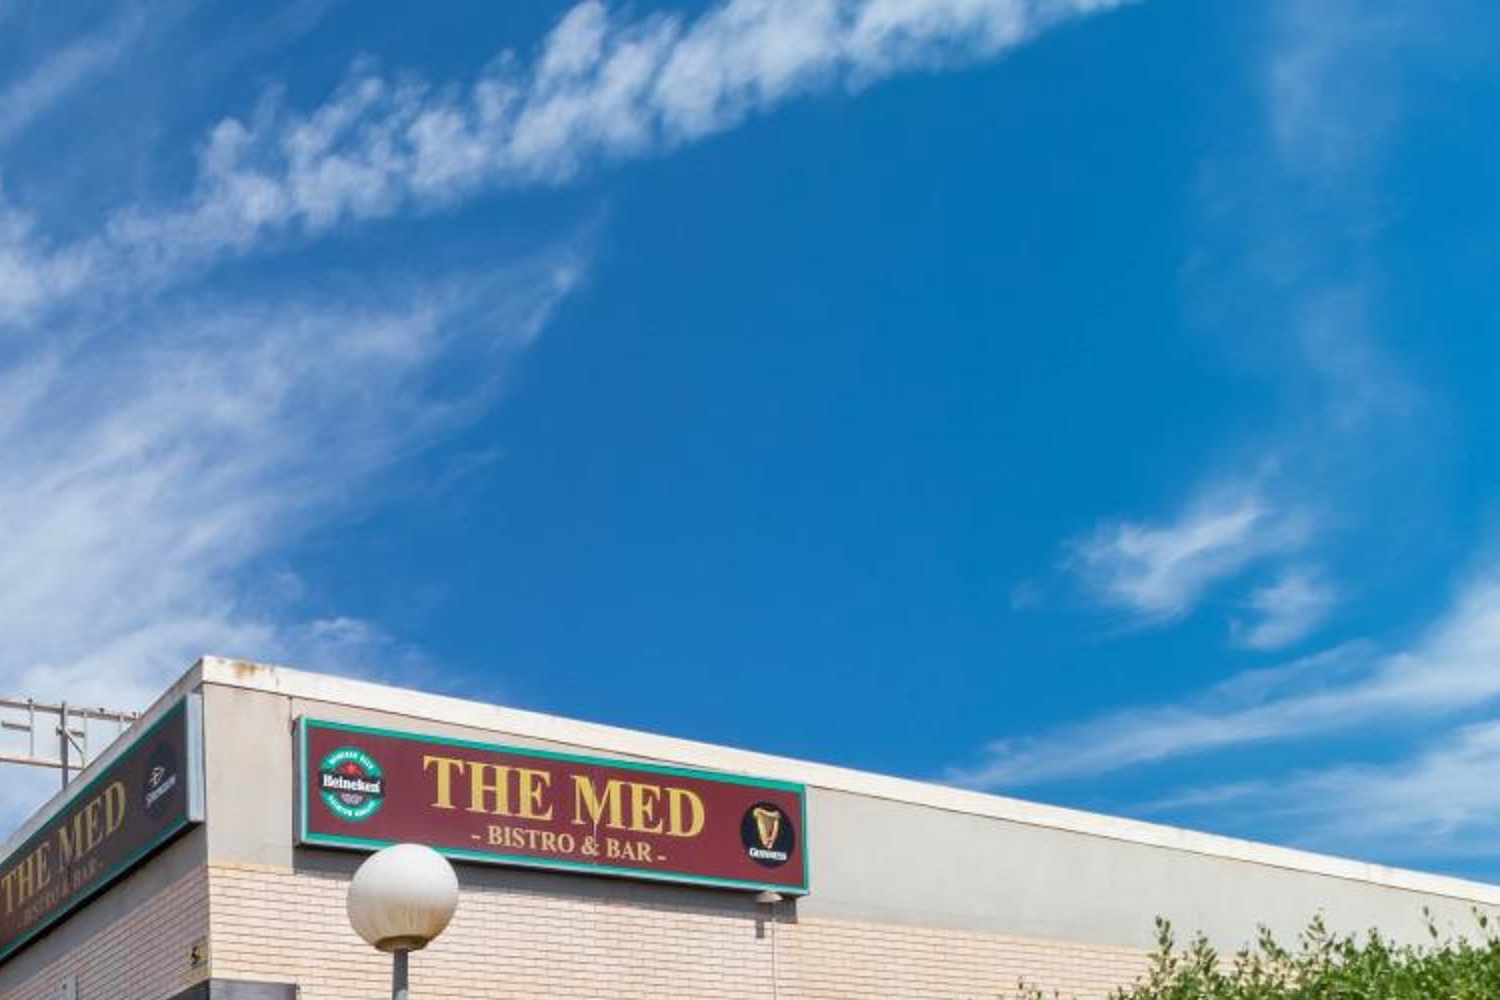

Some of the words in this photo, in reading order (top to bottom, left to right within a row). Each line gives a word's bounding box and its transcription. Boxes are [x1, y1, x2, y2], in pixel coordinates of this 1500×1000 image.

[323, 774, 381, 793] Heineken
[423, 755, 553, 821] THE
[571, 775, 705, 838] MED
[1, 843, 50, 913] THE
[57, 781, 127, 866] MED
[488, 825, 575, 853] BISTRO
[581, 835, 599, 856] &
[606, 838, 653, 862] BAR
